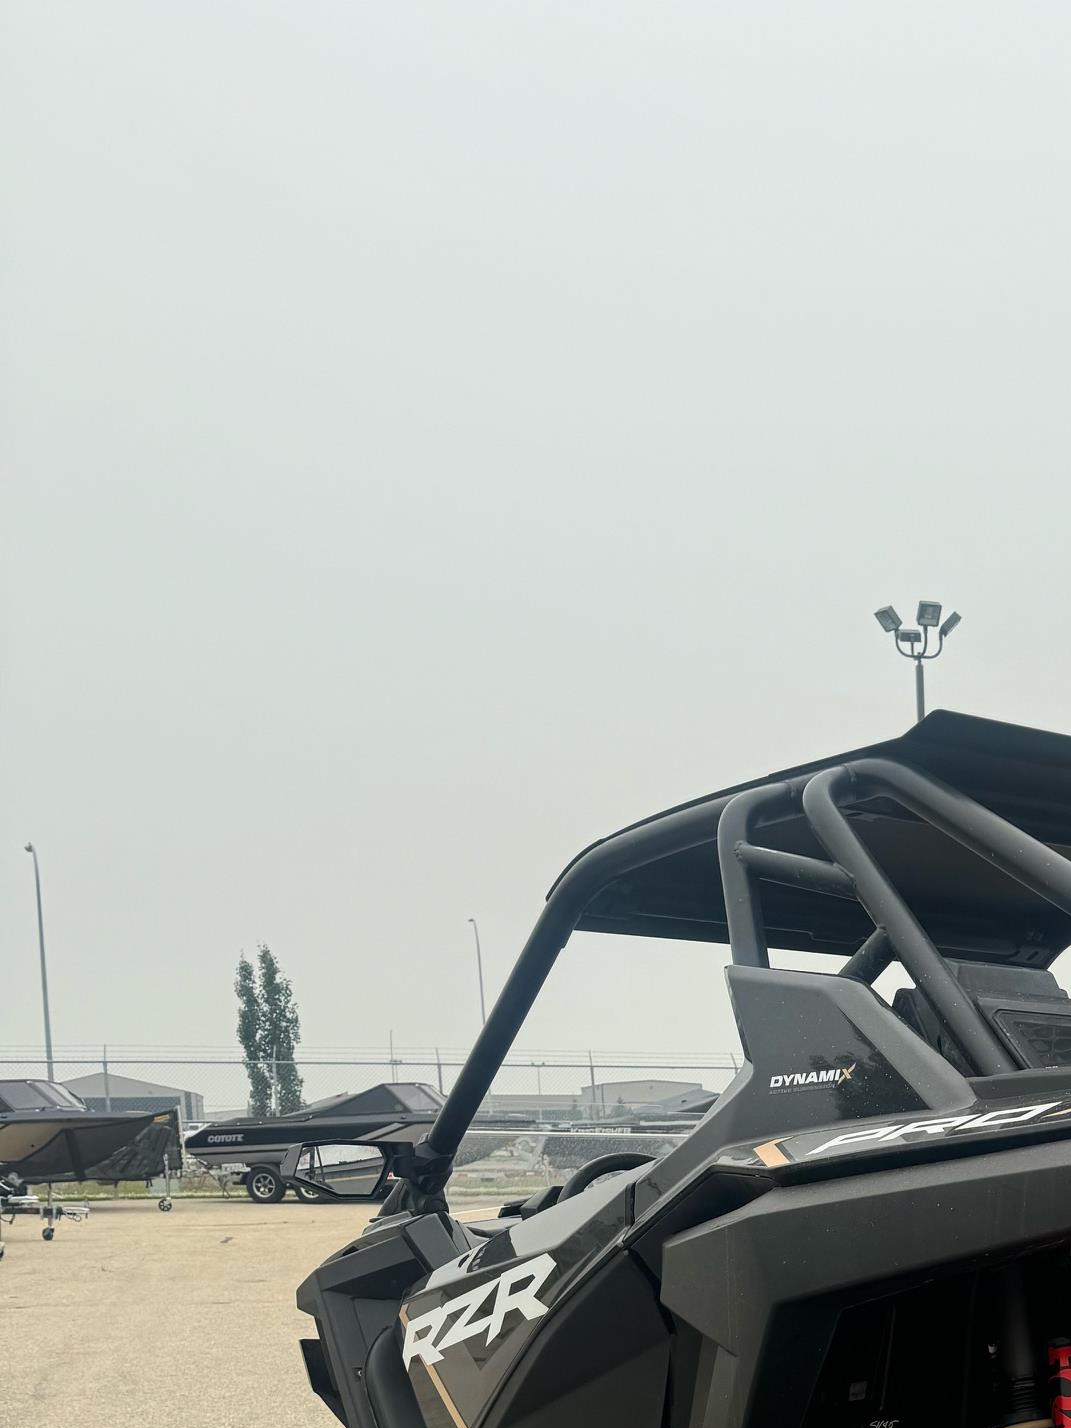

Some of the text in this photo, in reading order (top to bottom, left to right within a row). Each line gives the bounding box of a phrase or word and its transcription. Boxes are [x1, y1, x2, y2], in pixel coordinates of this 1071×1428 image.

[770, 1062, 856, 1087] DYNAMIX
[806, 1101, 1063, 1156] PRO
[402, 1252, 557, 1373] RZR
